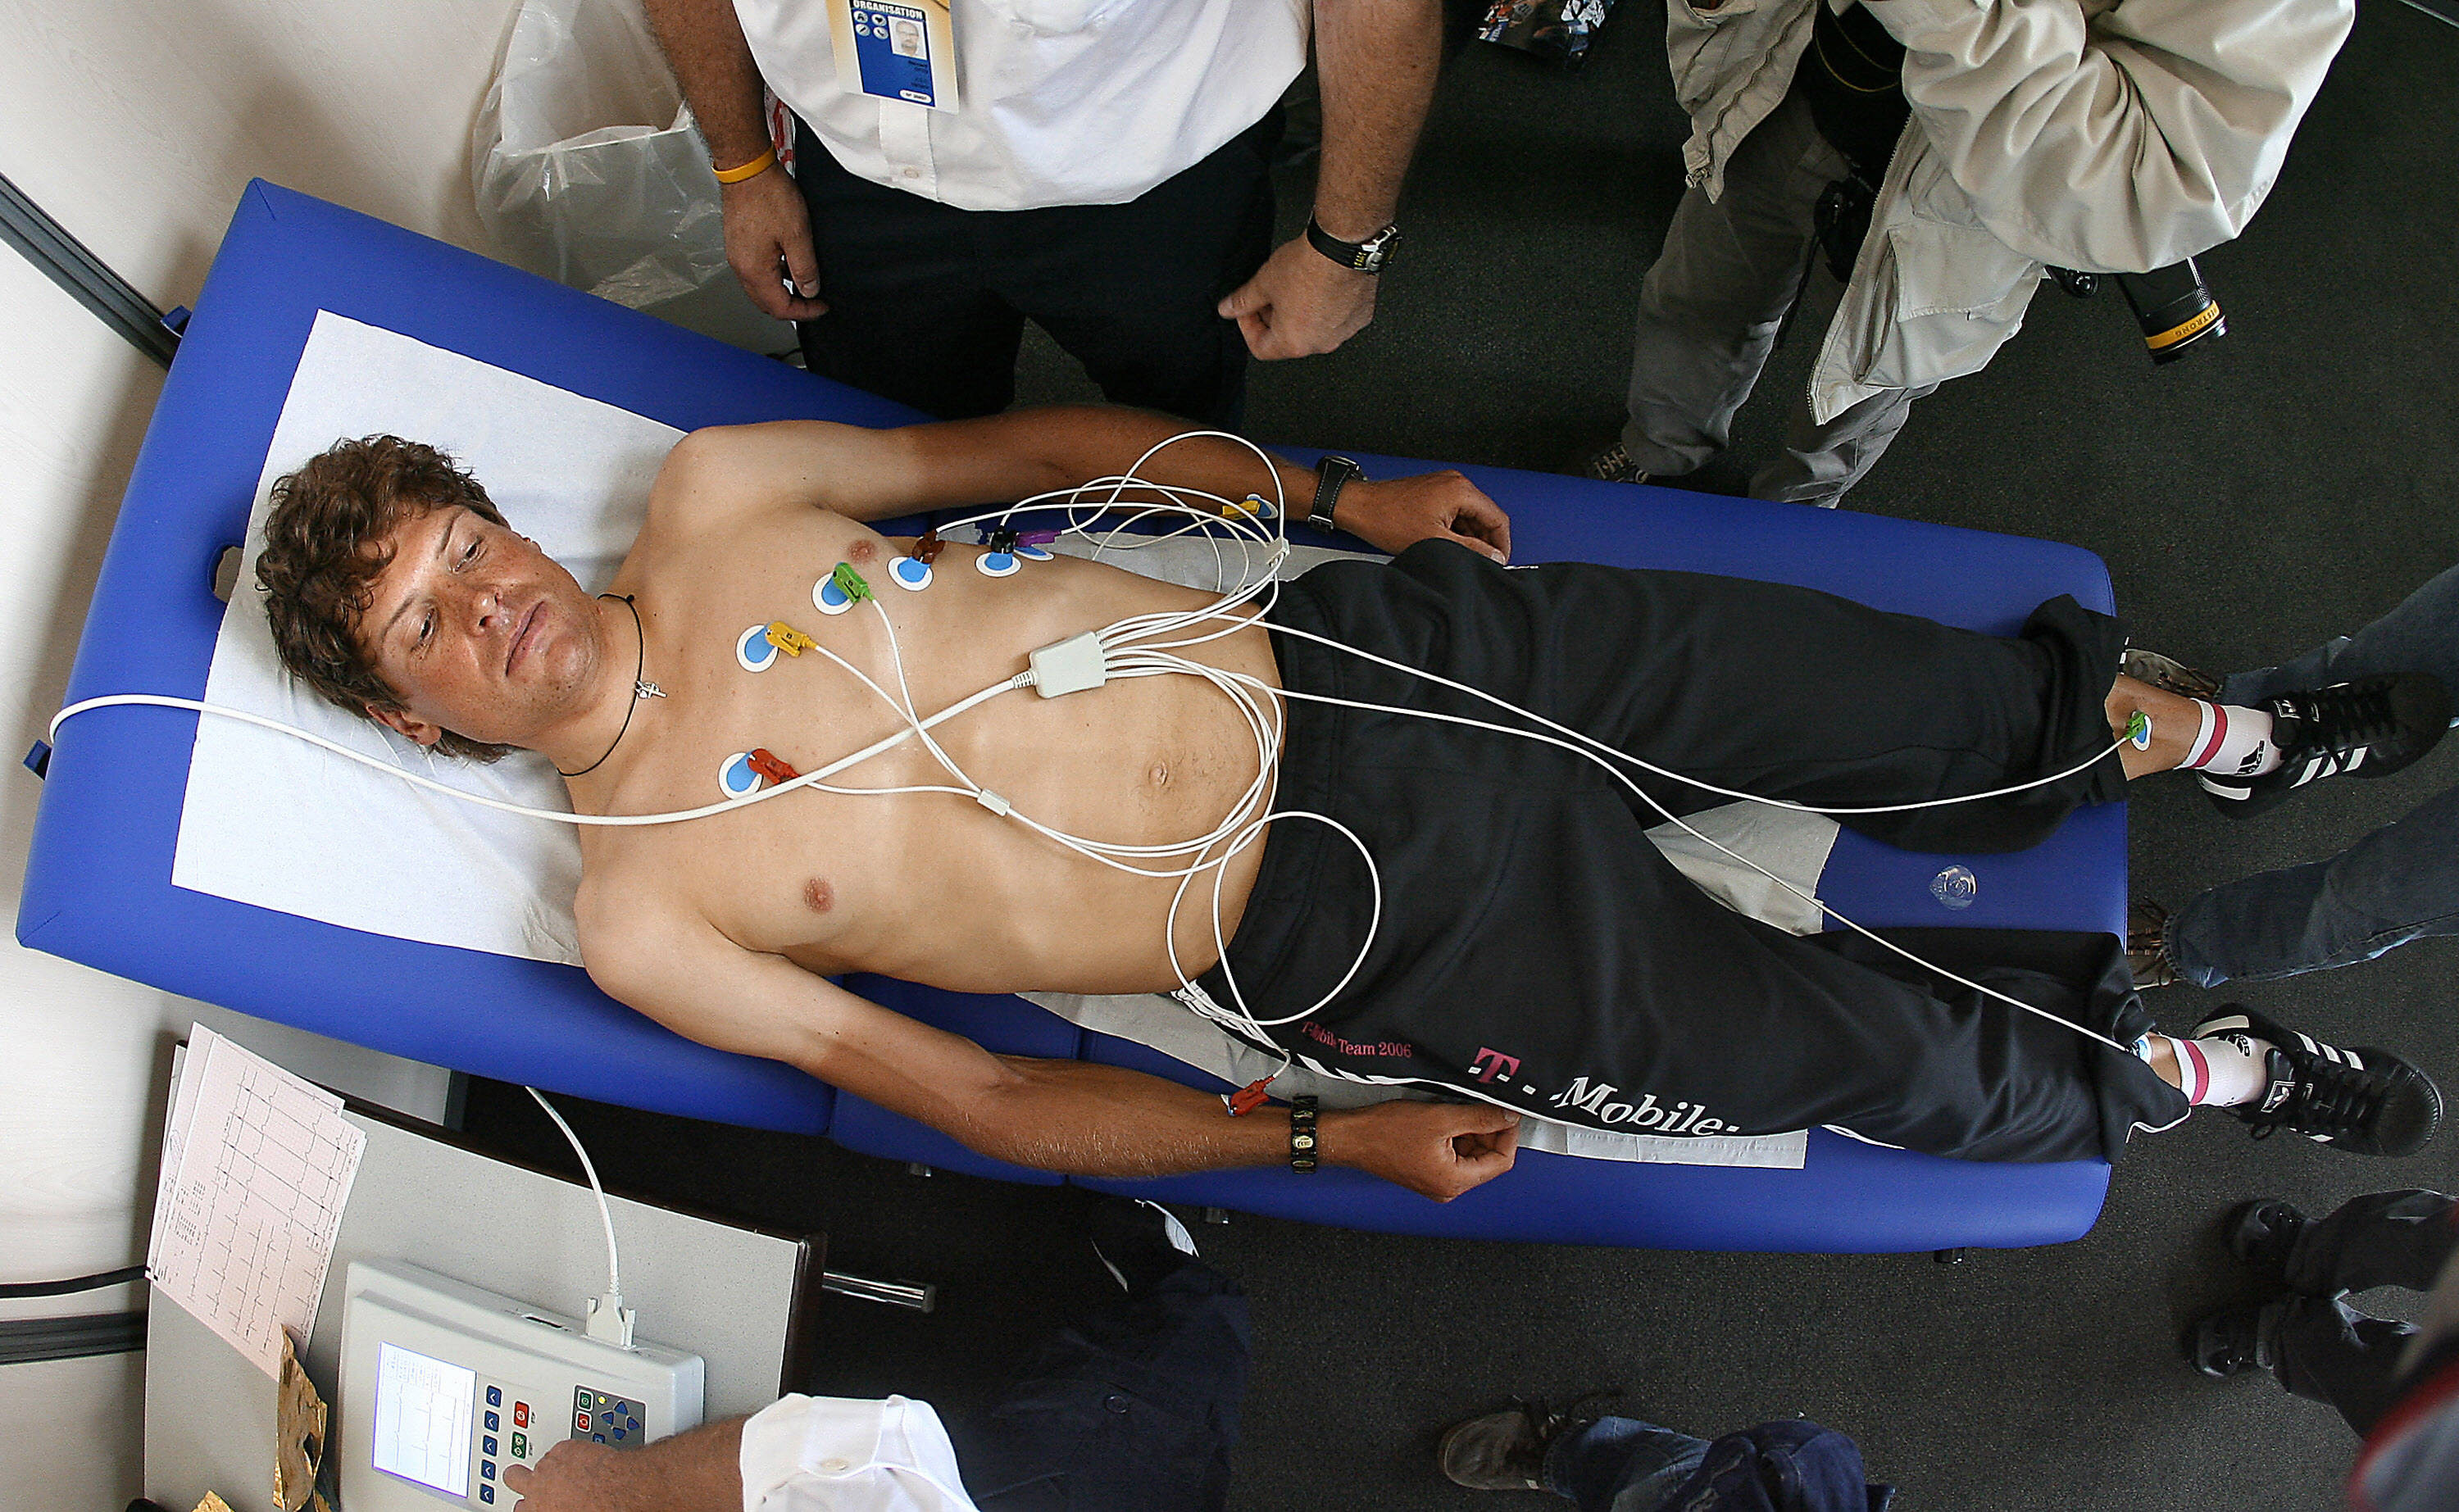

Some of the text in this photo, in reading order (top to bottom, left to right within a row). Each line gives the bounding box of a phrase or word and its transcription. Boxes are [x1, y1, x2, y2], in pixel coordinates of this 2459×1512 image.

[853, 0, 923, 20] ORGANISATION
[1338, 1038, 1376, 1056] Team
[1378, 1042, 1413, 1058] 2006
